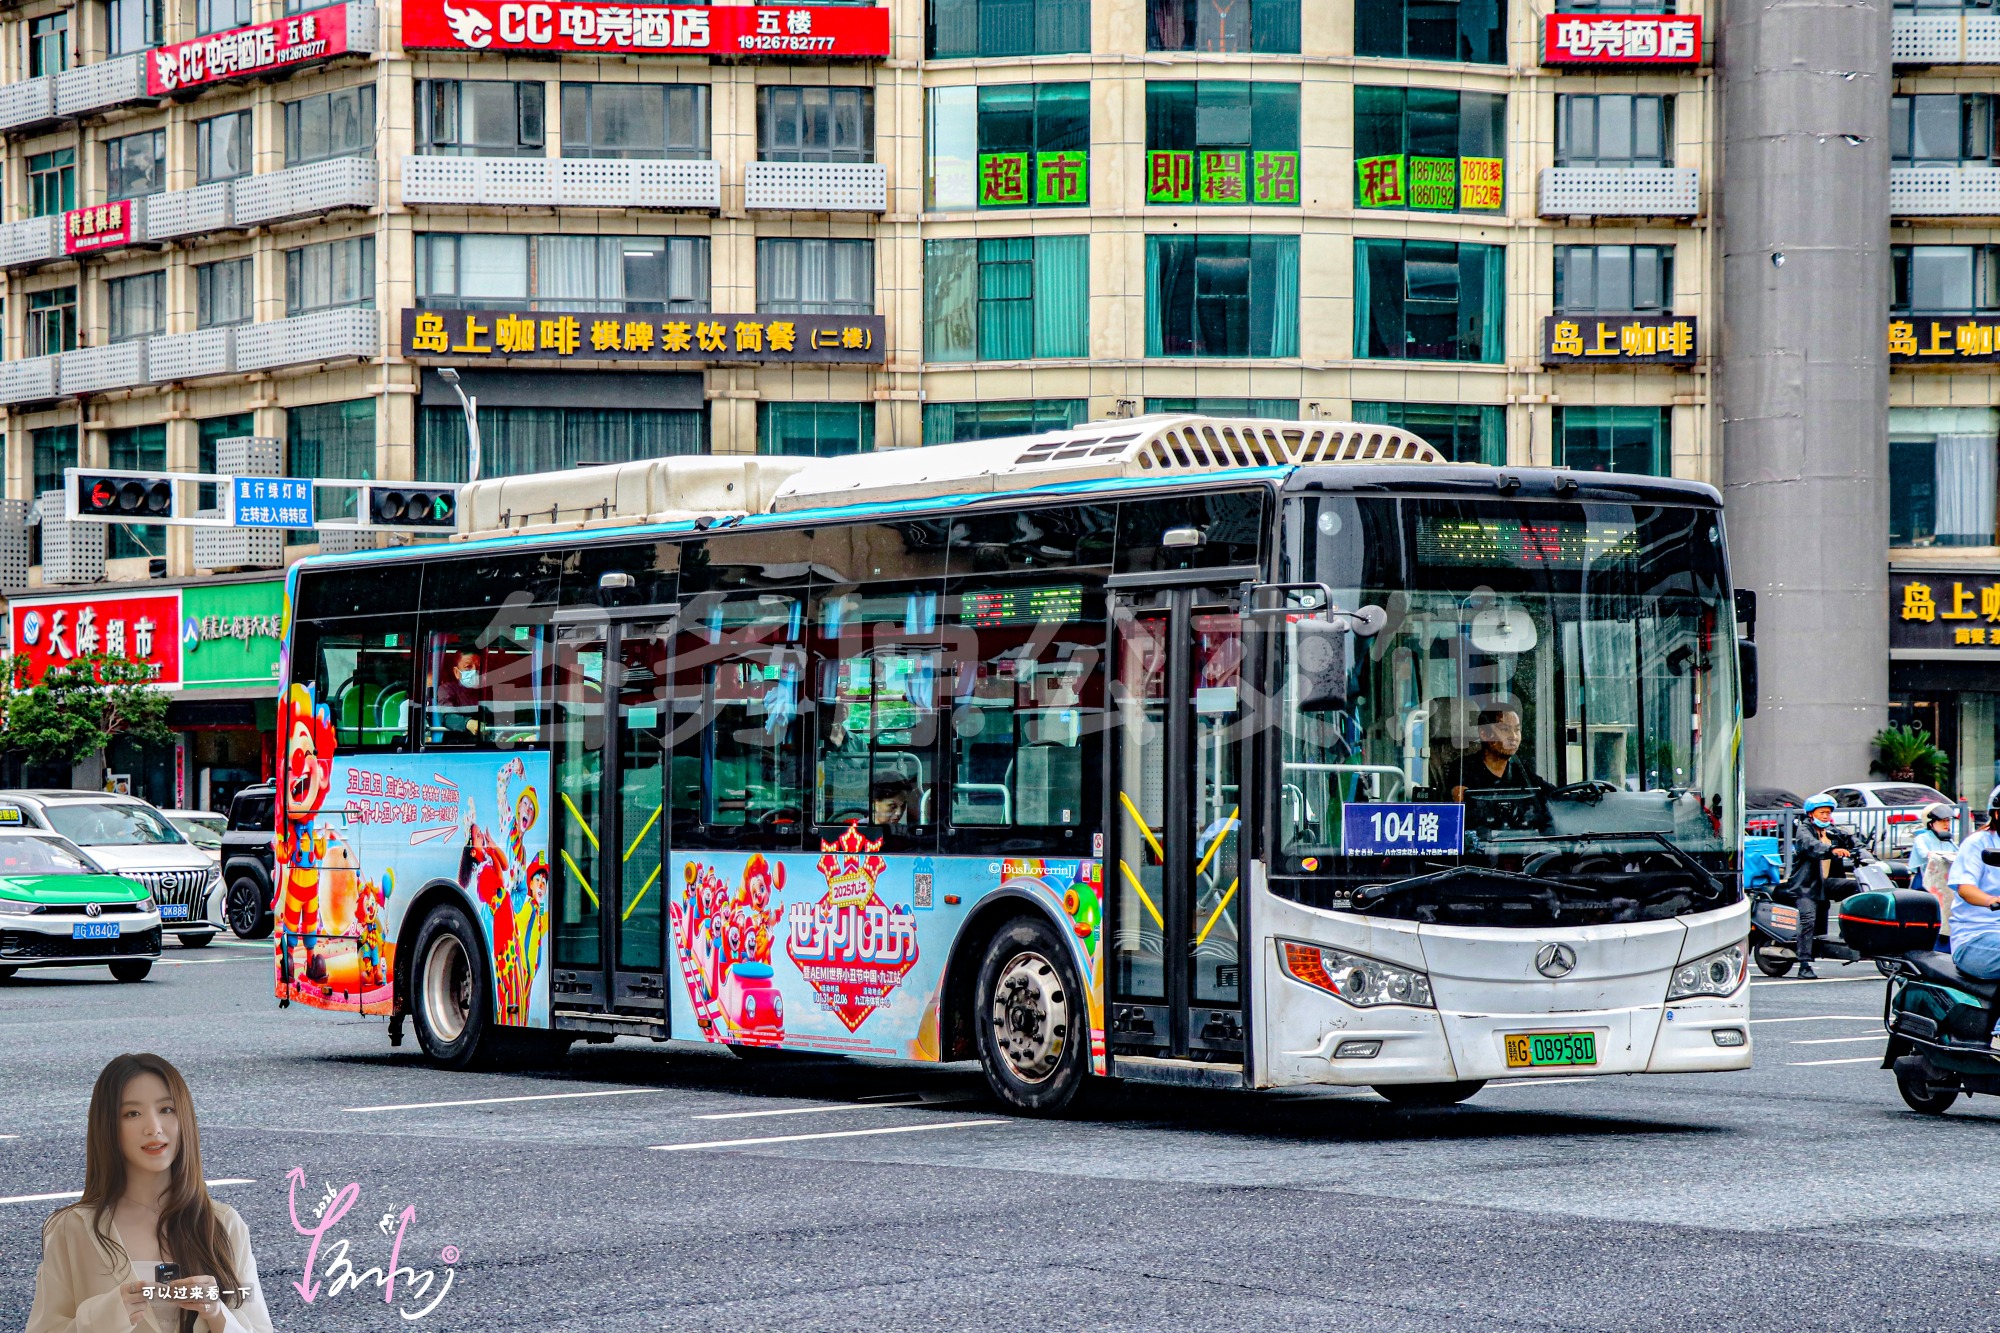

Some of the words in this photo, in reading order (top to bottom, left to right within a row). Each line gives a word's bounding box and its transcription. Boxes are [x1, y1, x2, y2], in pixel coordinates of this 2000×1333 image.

[287, 16, 316, 44] 五楼
[757, 10, 812, 35] 五楼
[276, 39, 326, 64] 19126782777
[738, 34, 835, 51] 19126782777
[1557, 20, 1695, 58] 电竞酒店
[413, 313, 580, 356] 岛上咖啡
[1551, 321, 1694, 357] 岛上咖啡
[1889, 320, 2000, 356] 岛上咖
[240, 481, 307, 500] 直行绿灯时
[240, 506, 309, 524] 左转进入待转区
[47, 606, 155, 659] 天海超市
[347, 768, 383, 796] 丑丑丑
[834, 882, 866, 898] 2025九江
[789, 903, 916, 960] 世界小丑节
